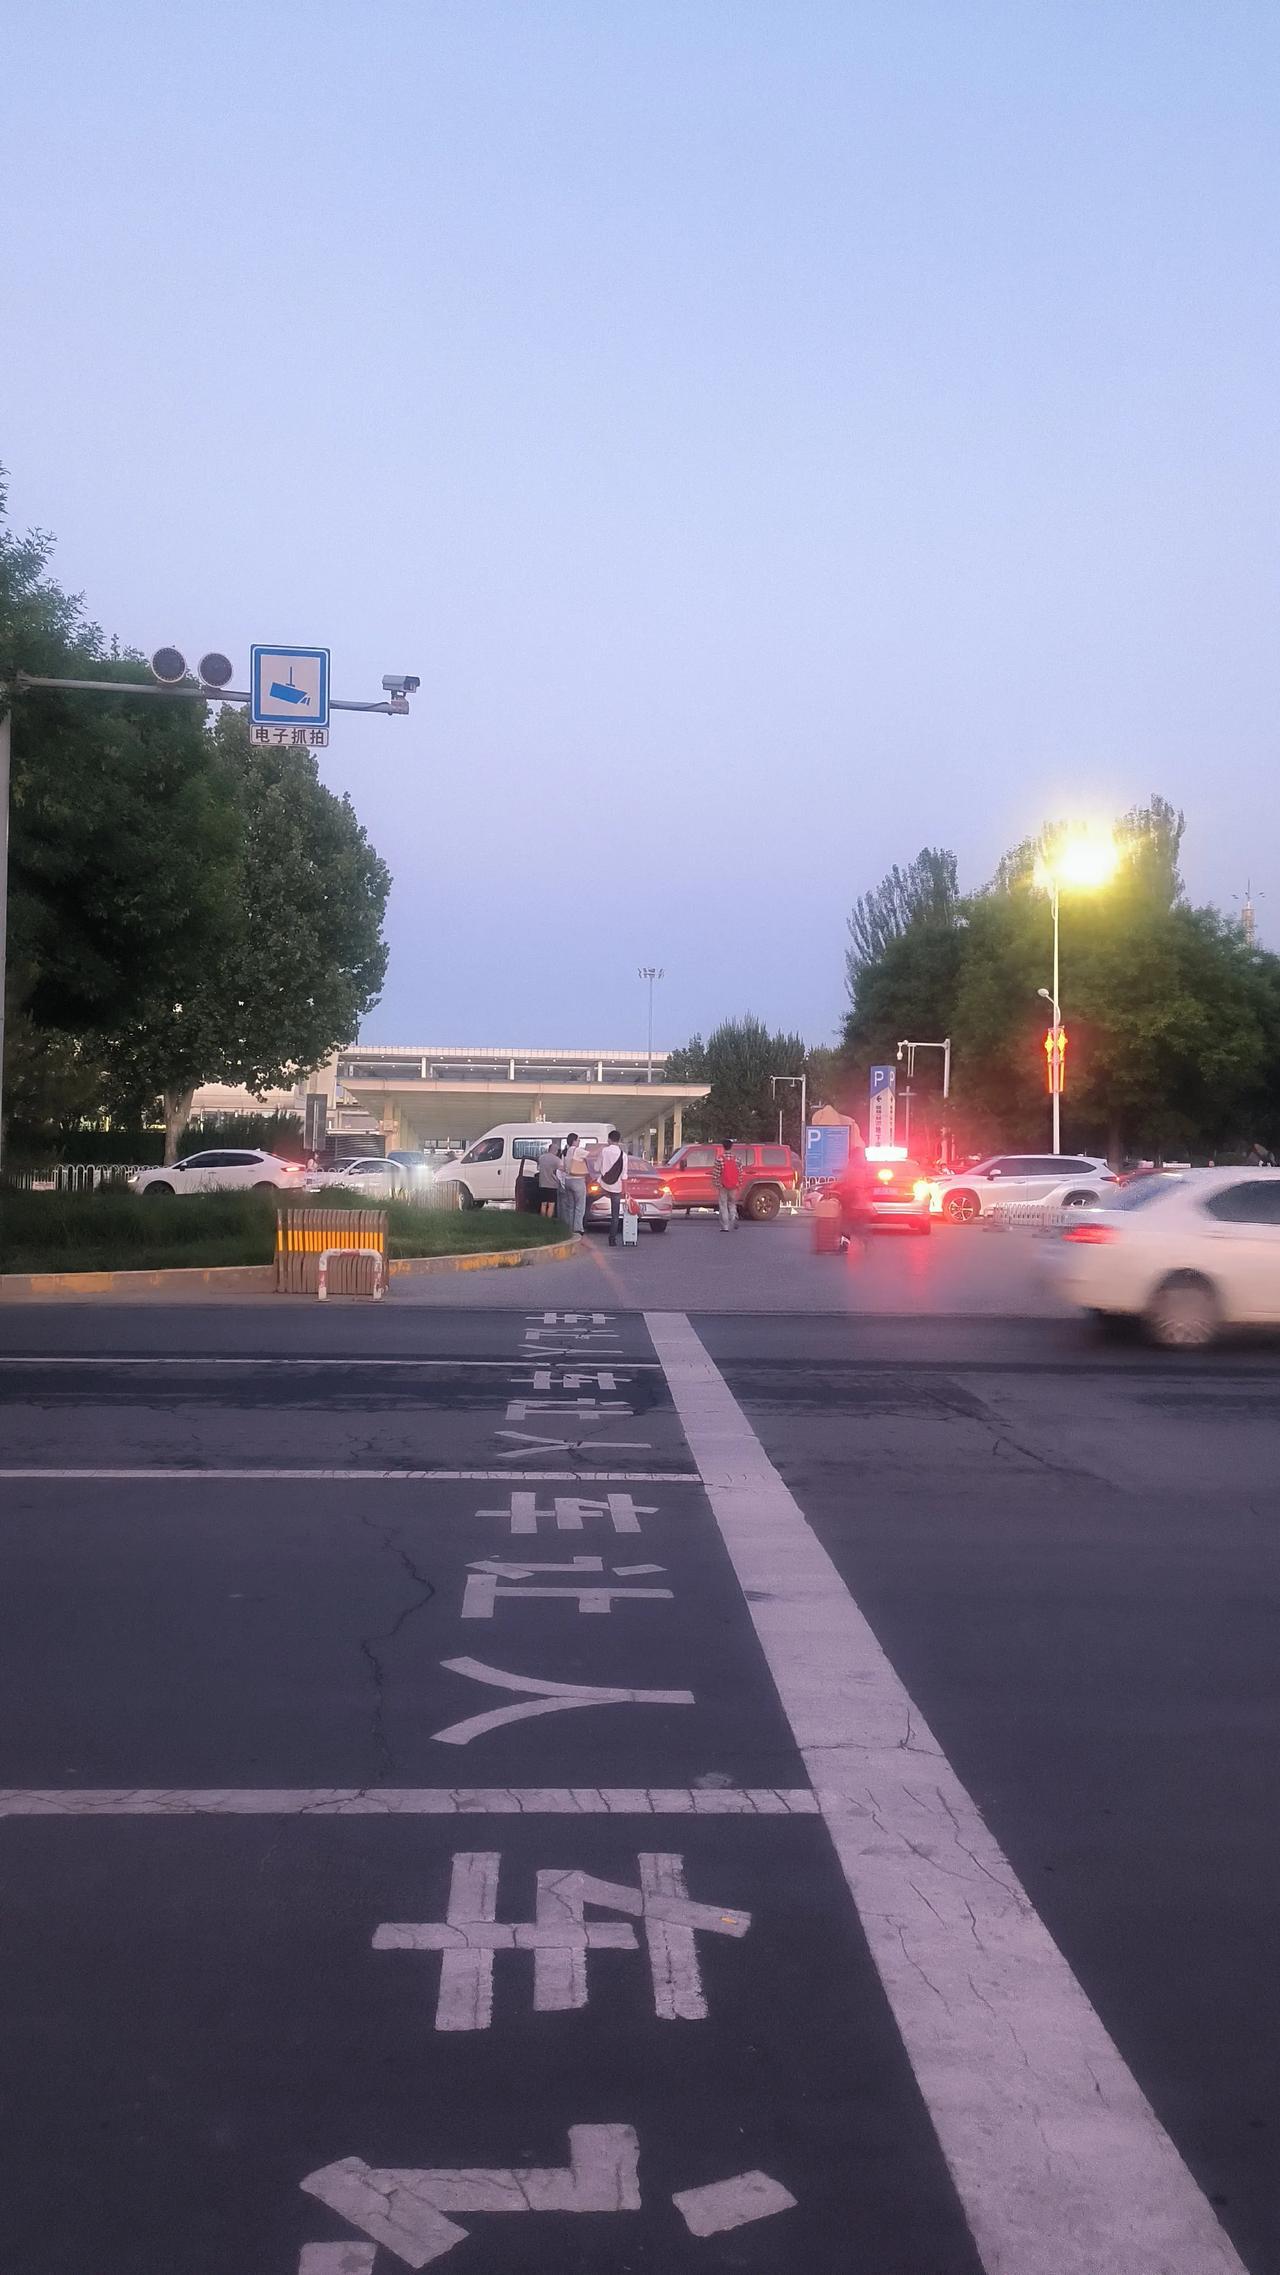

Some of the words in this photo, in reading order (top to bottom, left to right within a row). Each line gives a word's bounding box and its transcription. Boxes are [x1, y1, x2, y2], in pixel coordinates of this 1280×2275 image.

[255, 726, 324, 744] 电子抓拍
[874, 1070, 884, 1087] P
[807, 1129, 821, 1150] P
[494, 1371, 651, 1458] 车让人
[429, 1491, 696, 1745] 车让人
